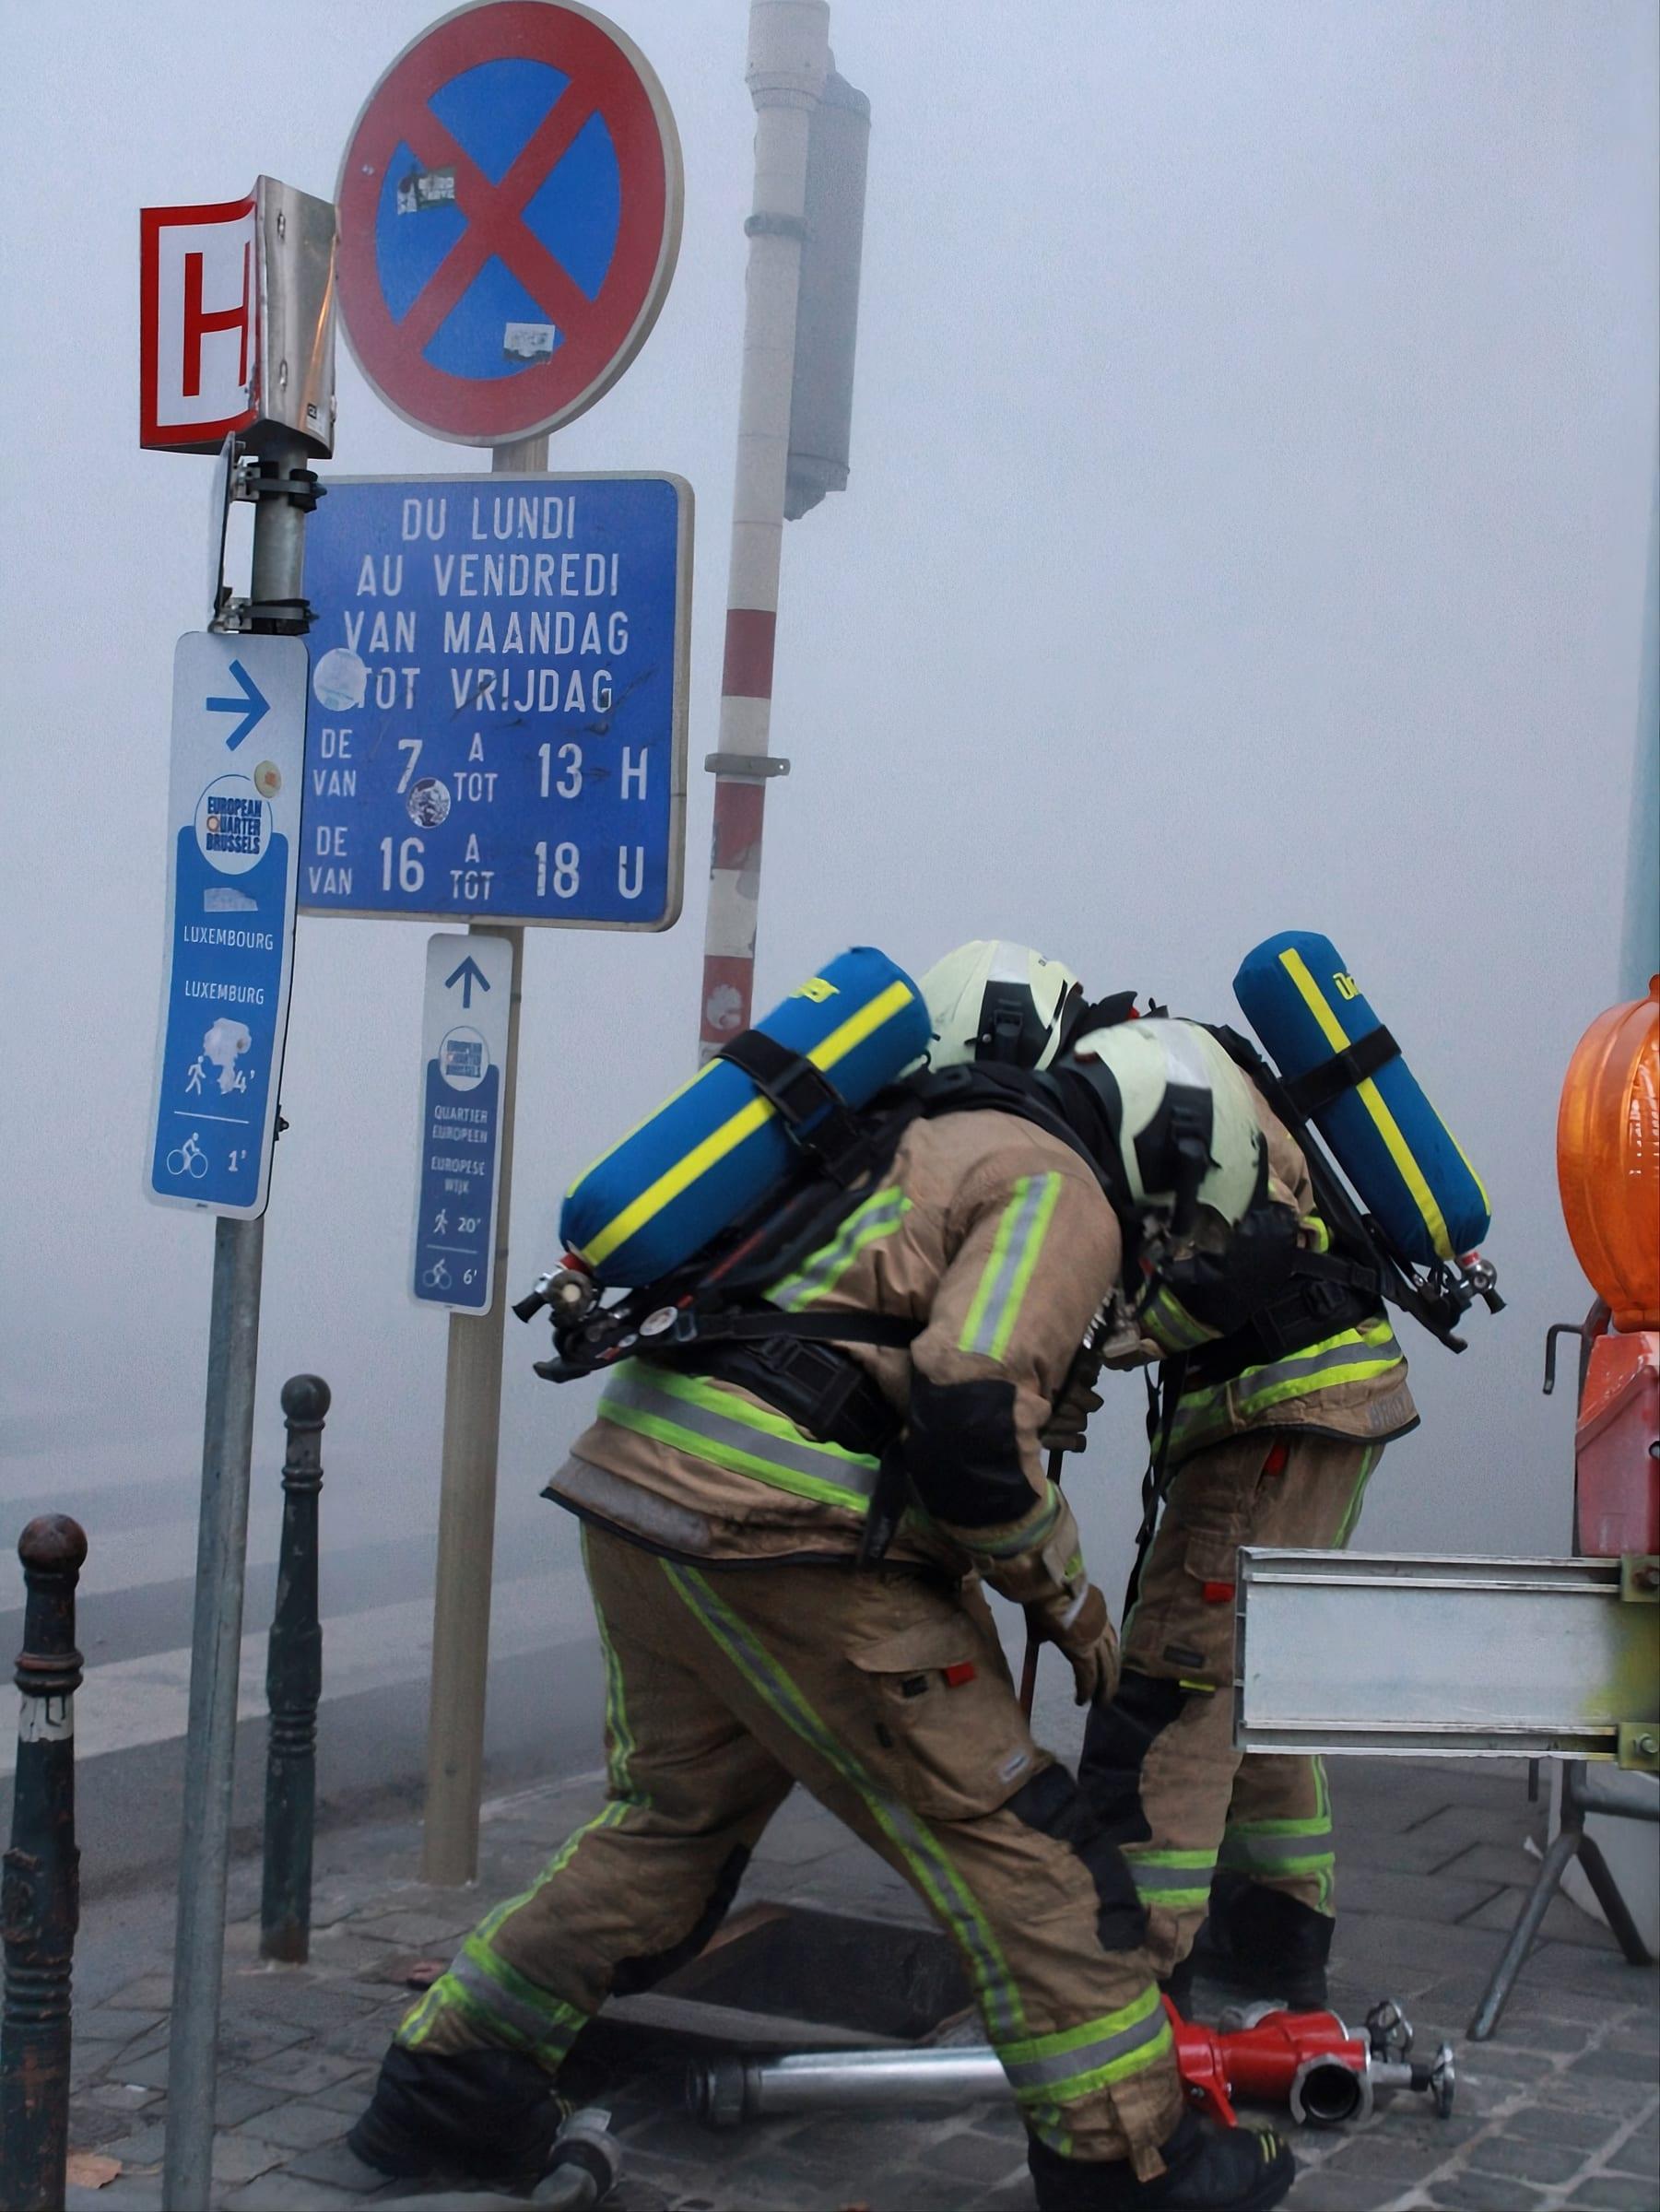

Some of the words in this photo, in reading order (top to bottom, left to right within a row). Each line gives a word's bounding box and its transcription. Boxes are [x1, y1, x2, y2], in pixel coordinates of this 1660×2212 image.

[182, 241, 251, 397] H
[402, 498, 447, 541] DU
[472, 496, 576, 540] LUNDI
[356, 554, 403, 597] AU
[433, 553, 619, 597] VENDREDI
[344, 610, 417, 653] VAN
[442, 610, 629, 655] MAANDAG
[450, 668, 613, 713] VRIJDAG
[321, 728, 353, 759] DE
[396, 739, 423, 794] 7
[467, 733, 484, 763] A
[537, 743, 583, 800] 13
[620, 746, 649, 801] H
[312, 770, 357, 797] VAN
[453, 771, 499, 803] TOT
[207, 796, 262, 818] EUROPEAN
[206, 832, 260, 854] BRUSSELS
[316, 826, 349, 856] DE
[379, 836, 425, 893] 16
[464, 833, 480, 863] A
[534, 841, 580, 898] 18
[618, 845, 644, 900] U
[308, 866, 353, 895] VAN
[450, 869, 495, 900] TOT
[183, 924, 275, 950] LUXEMBOURG
[184, 980, 265, 1006] LUXEMBURG
[434, 1105, 488, 1124] QUARTIER
[430, 1156, 486, 1176] EUROPESE
